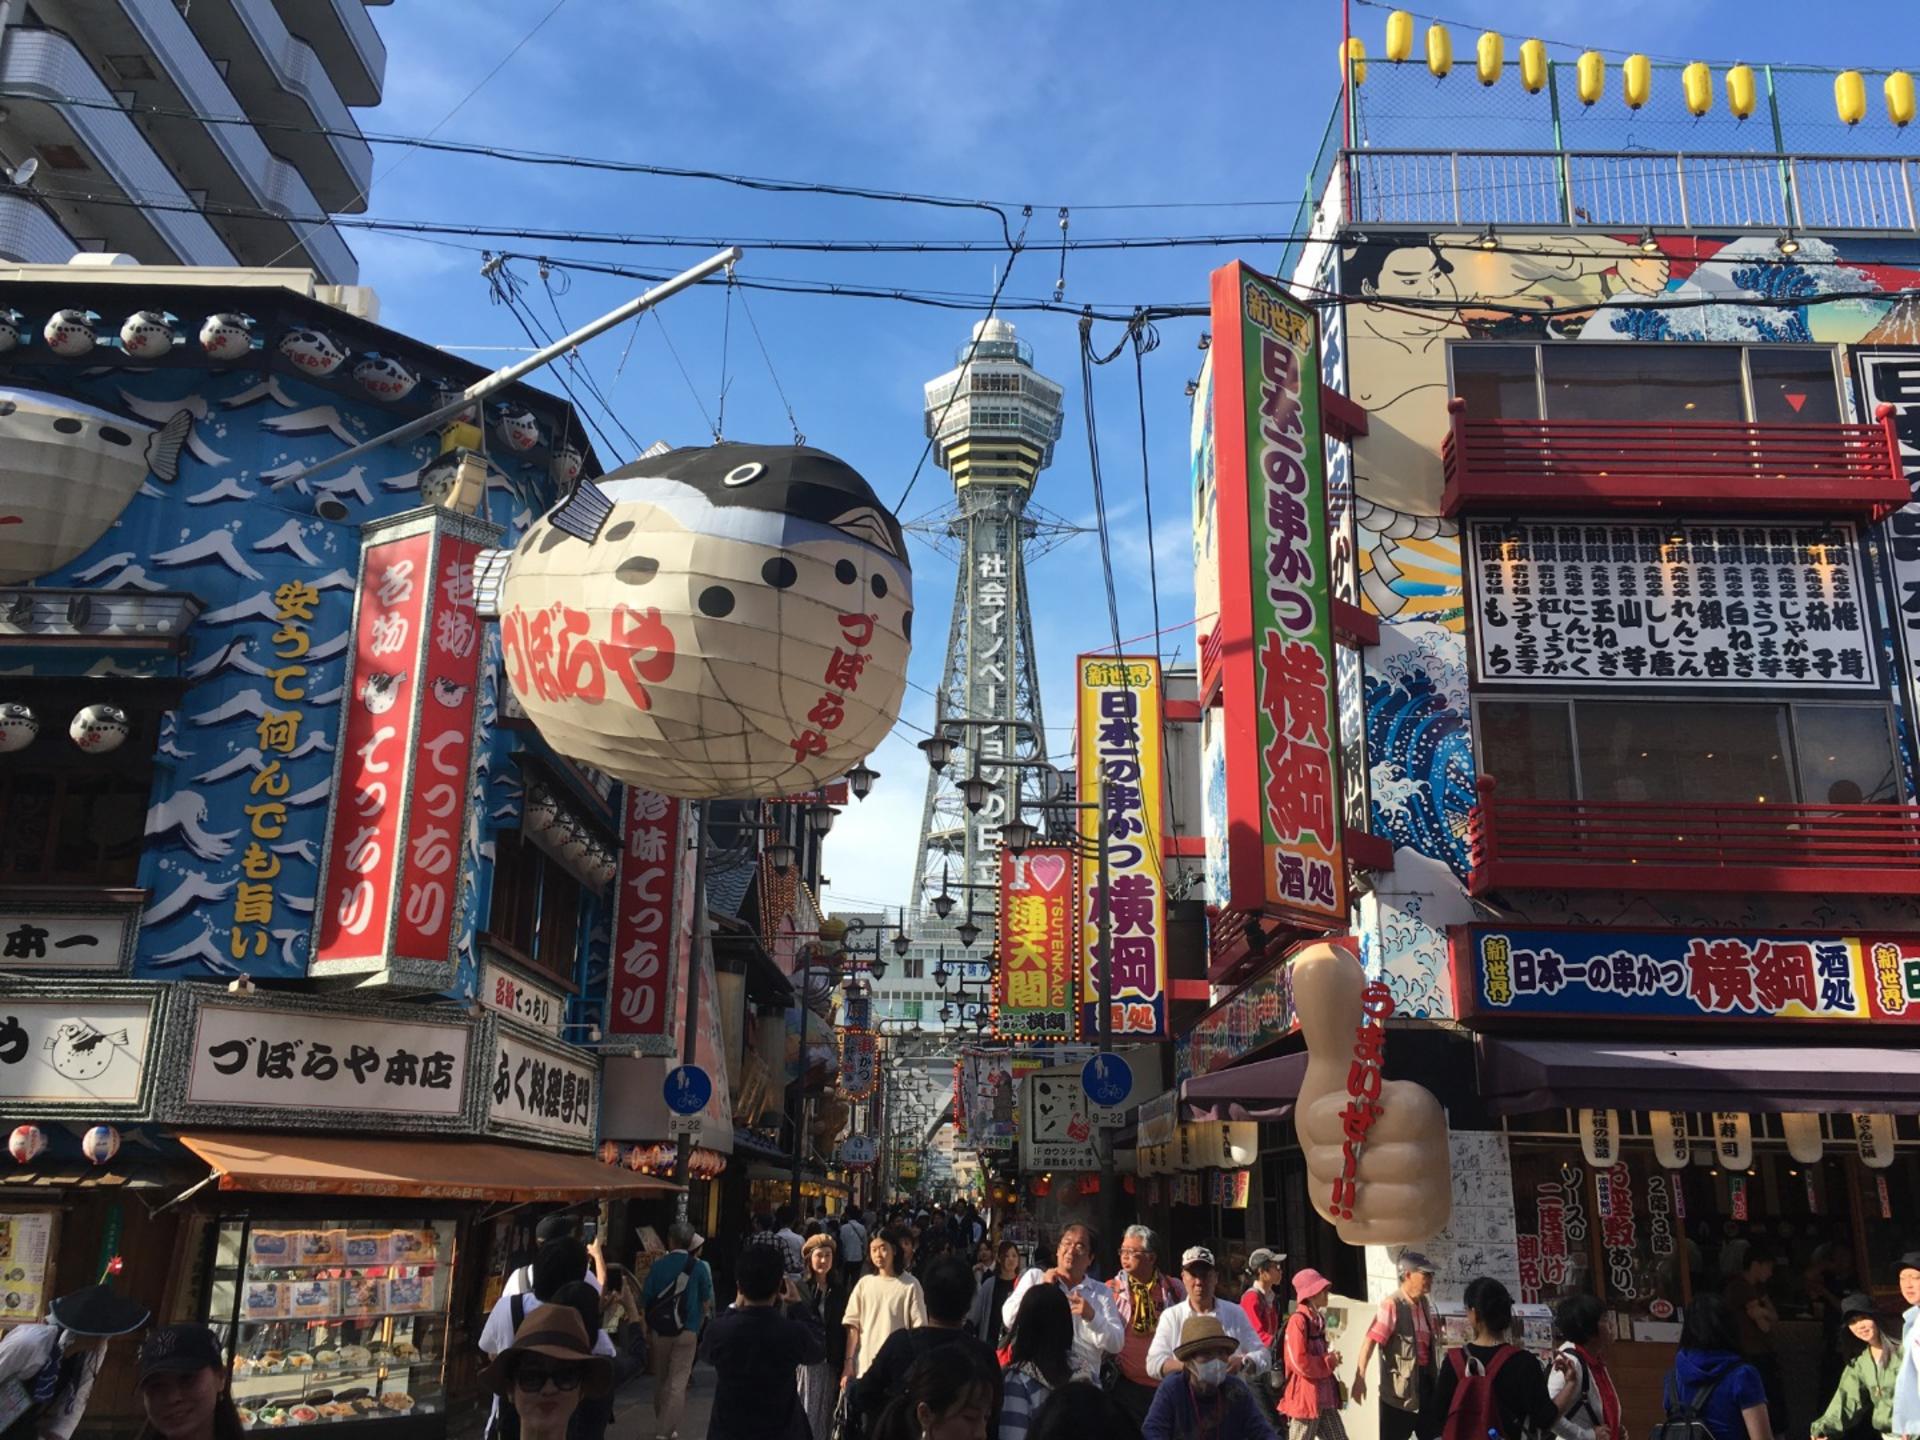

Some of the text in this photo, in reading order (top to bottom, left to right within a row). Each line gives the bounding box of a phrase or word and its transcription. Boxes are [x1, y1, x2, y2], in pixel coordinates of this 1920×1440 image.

[1246, 284, 1310, 352] 新世界
[1261, 335, 1313, 630] 日本一の串かつ
[500, 602, 676, 711] づぼらや
[1484, 597, 1512, 674] もち
[1511, 597, 1541, 674] うずら玉子
[1537, 598, 1568, 674] 紅しょうが
[1563, 599, 1593, 675] にんにく
[1591, 599, 1621, 676] 玉ねぎ
[1617, 599, 1648, 676] 山芋
[1644, 599, 1676, 677] しし唐
[1671, 600, 1703, 677] れんこん
[1697, 600, 1730, 678] 銀杏
[1725, 600, 1757, 678] 白ねぎ
[1752, 601, 1784, 679] さつま芋
[1779, 601, 1811, 679] じゃが芋
[1805, 601, 1838, 679] 茄子
[1831, 601, 1864, 680] 椎茸
[790, 612, 880, 763] づぼらや
[1085, 663, 1151, 687] 新世界
[231, 579, 319, 959] 安うて何んでも旨い
[336, 558, 416, 936] 名物 てっちり
[1261, 630, 1335, 852] 横綱
[1099, 690, 1143, 871] 日本一の串かつ
[403, 729, 467, 936] てっちり
[1278, 851, 1335, 906] 酒処
[1007, 895, 1049, 1008] 通天閣
[1051, 896, 1064, 1007] TSUTENKAKU
[1089, 873, 1157, 999] 横綱
[1485, 938, 1512, 1004] 新世界
[1514, 952, 1684, 994] 日本一の串かつ
[1688, 939, 1818, 1012] 横綱
[1816, 944, 1856, 1011] 酒処
[1876, 945, 1905, 1014] 新世界
[208, 1037, 456, 1090] づぼらや本店
[492, 1049, 591, 1127] ふぐ料理専門
[1537, 1182, 1567, 1285] 二度漬け
[1561, 1167, 1587, 1241] ソースの
